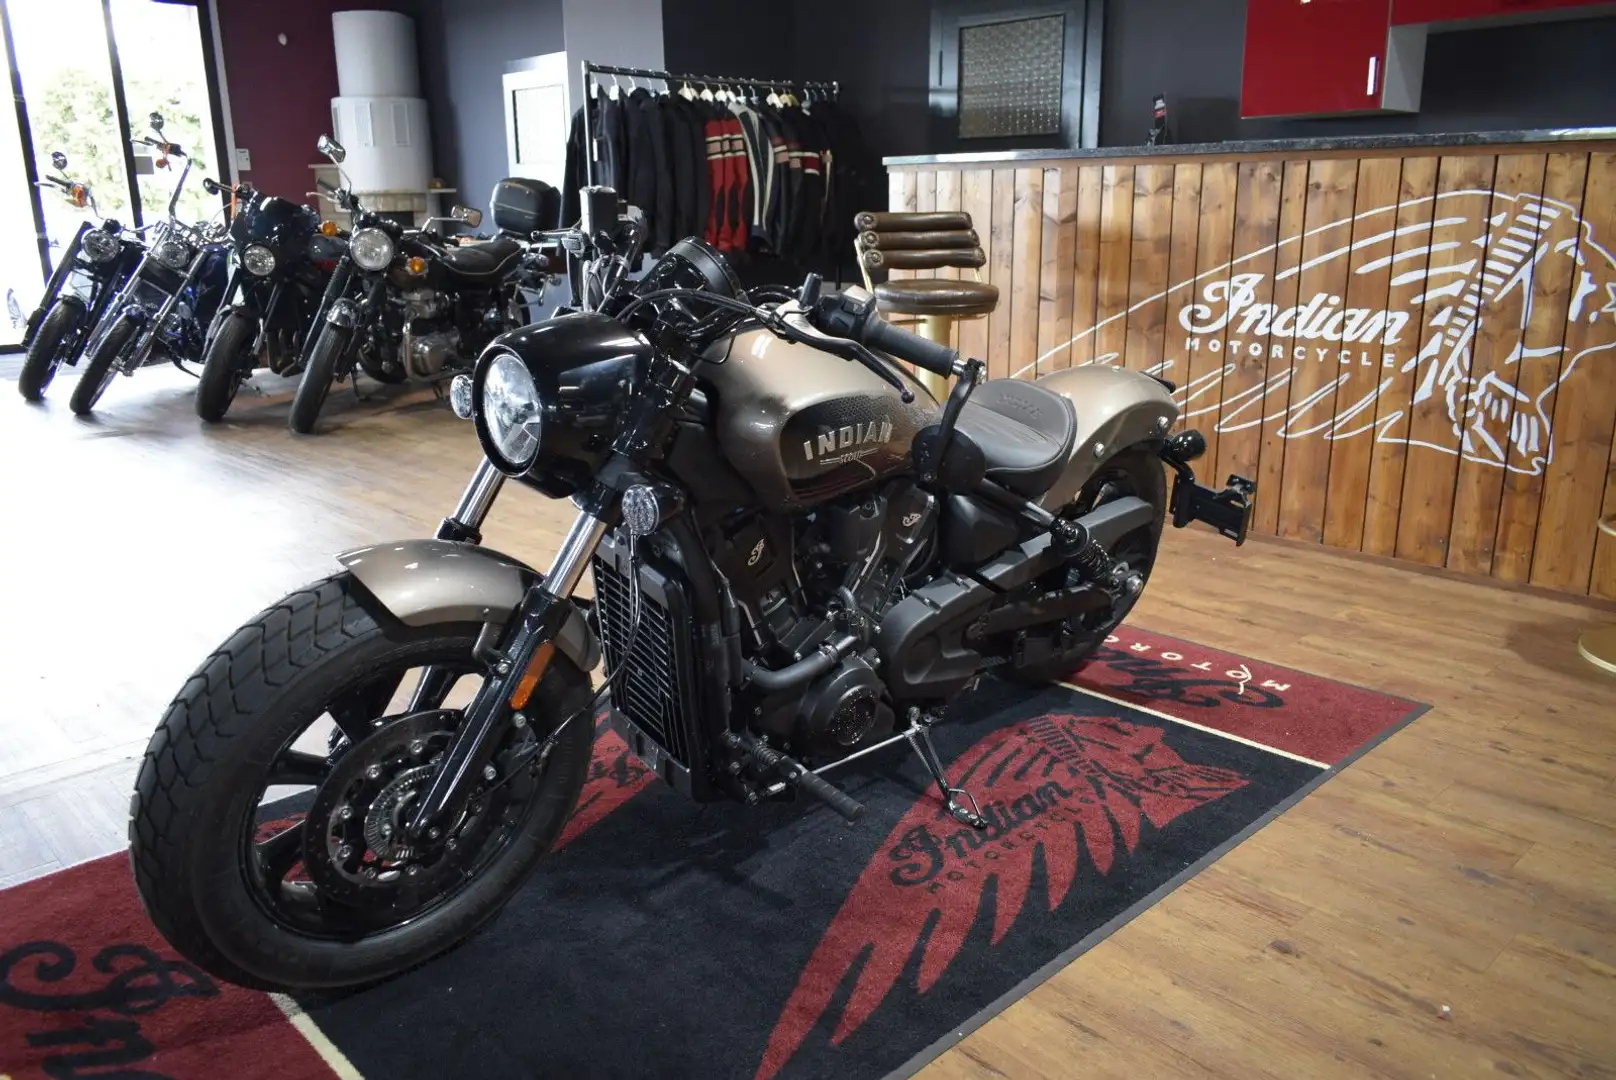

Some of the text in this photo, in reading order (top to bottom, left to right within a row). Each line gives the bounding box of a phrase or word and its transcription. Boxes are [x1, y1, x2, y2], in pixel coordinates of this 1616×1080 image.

[1178, 272, 1410, 346] Indian
[1185, 336, 1396, 368] MOTORCYCLE
[803, 421, 893, 461] INDIAN
[1103, 635, 1291, 692] MOTORC
